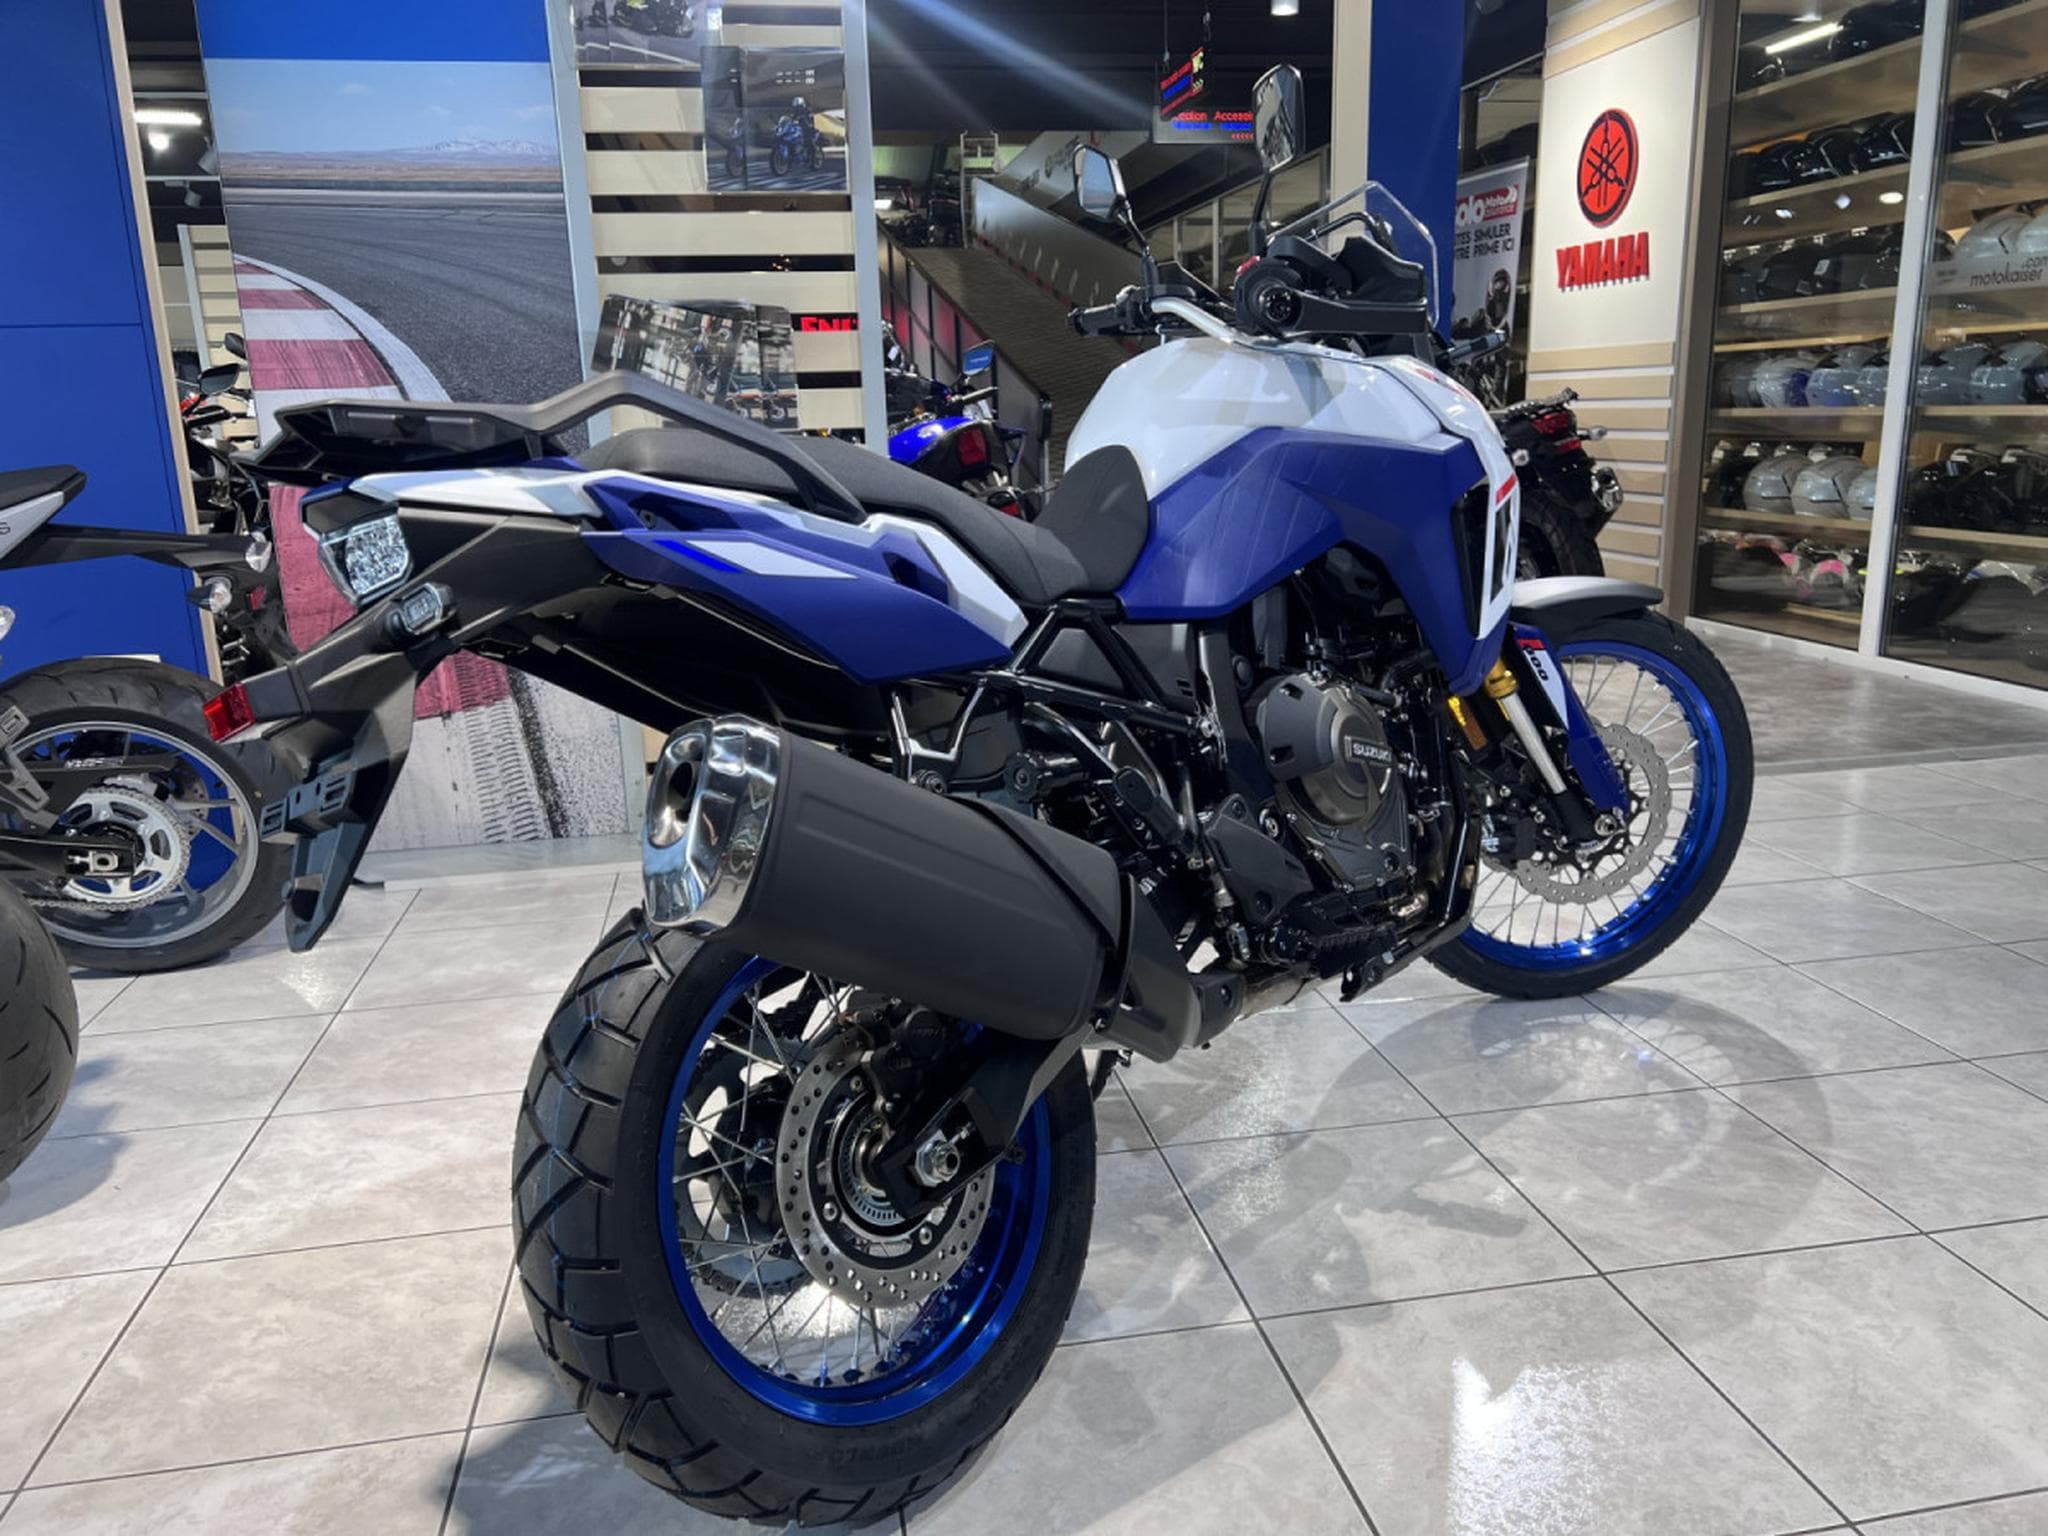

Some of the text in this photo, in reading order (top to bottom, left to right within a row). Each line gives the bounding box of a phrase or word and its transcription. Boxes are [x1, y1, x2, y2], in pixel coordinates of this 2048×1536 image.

[1474, 223, 1511, 243] SIMULER
[1556, 231, 1650, 289] YAMAHA
[1353, 743, 1392, 761] SUZUKI
